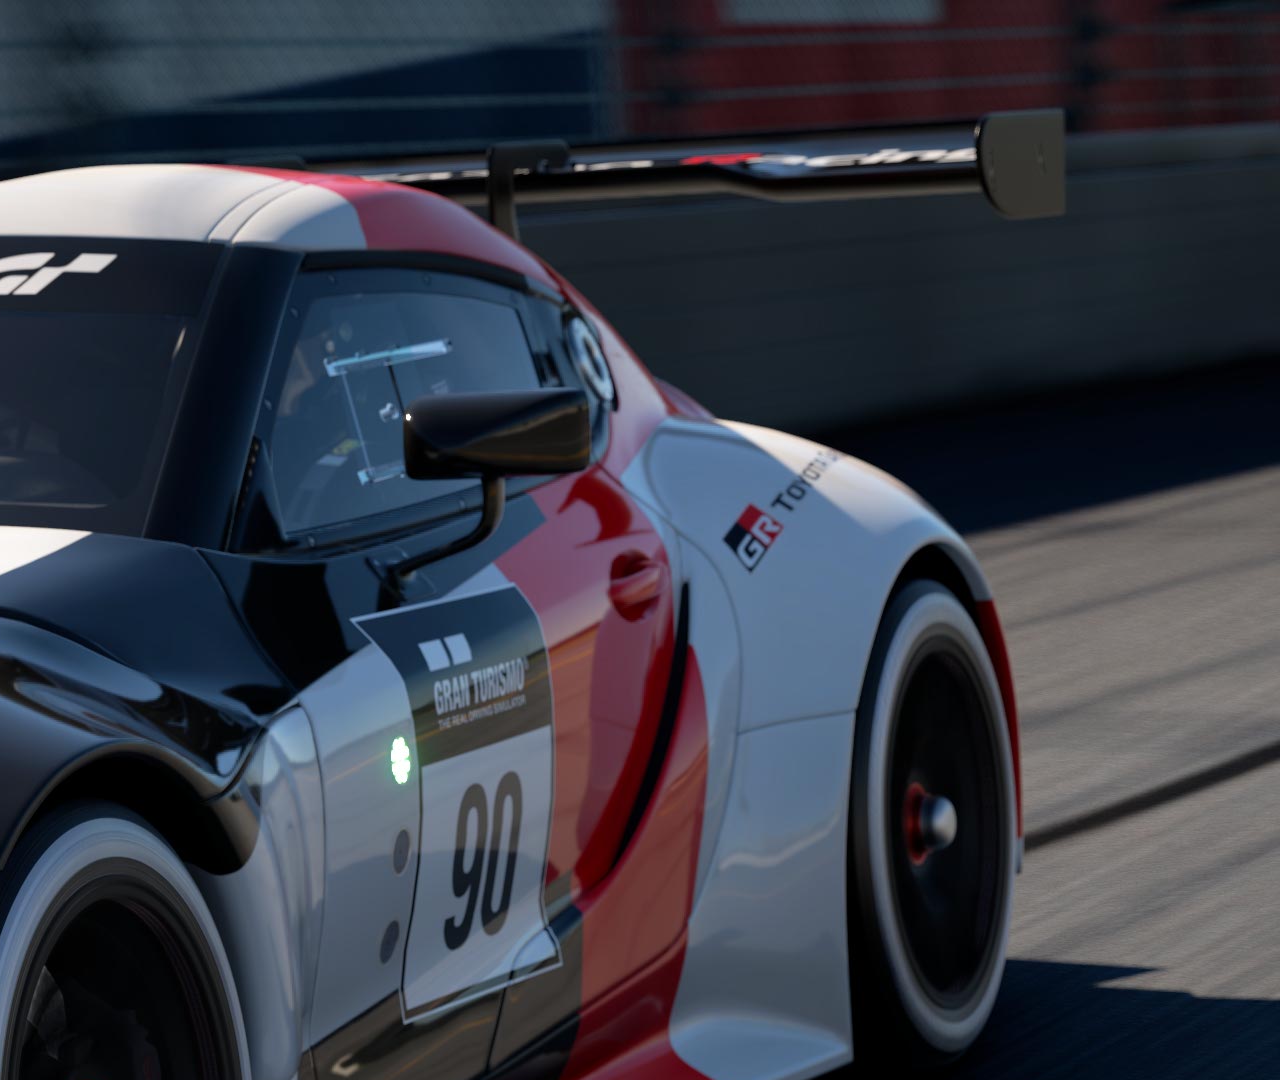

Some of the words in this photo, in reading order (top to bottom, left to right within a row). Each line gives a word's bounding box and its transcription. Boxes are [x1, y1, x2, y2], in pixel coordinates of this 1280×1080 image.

[736, 512, 783, 567] GR
[433, 673, 471, 717] GRAN
[443, 770, 523, 951] 90
